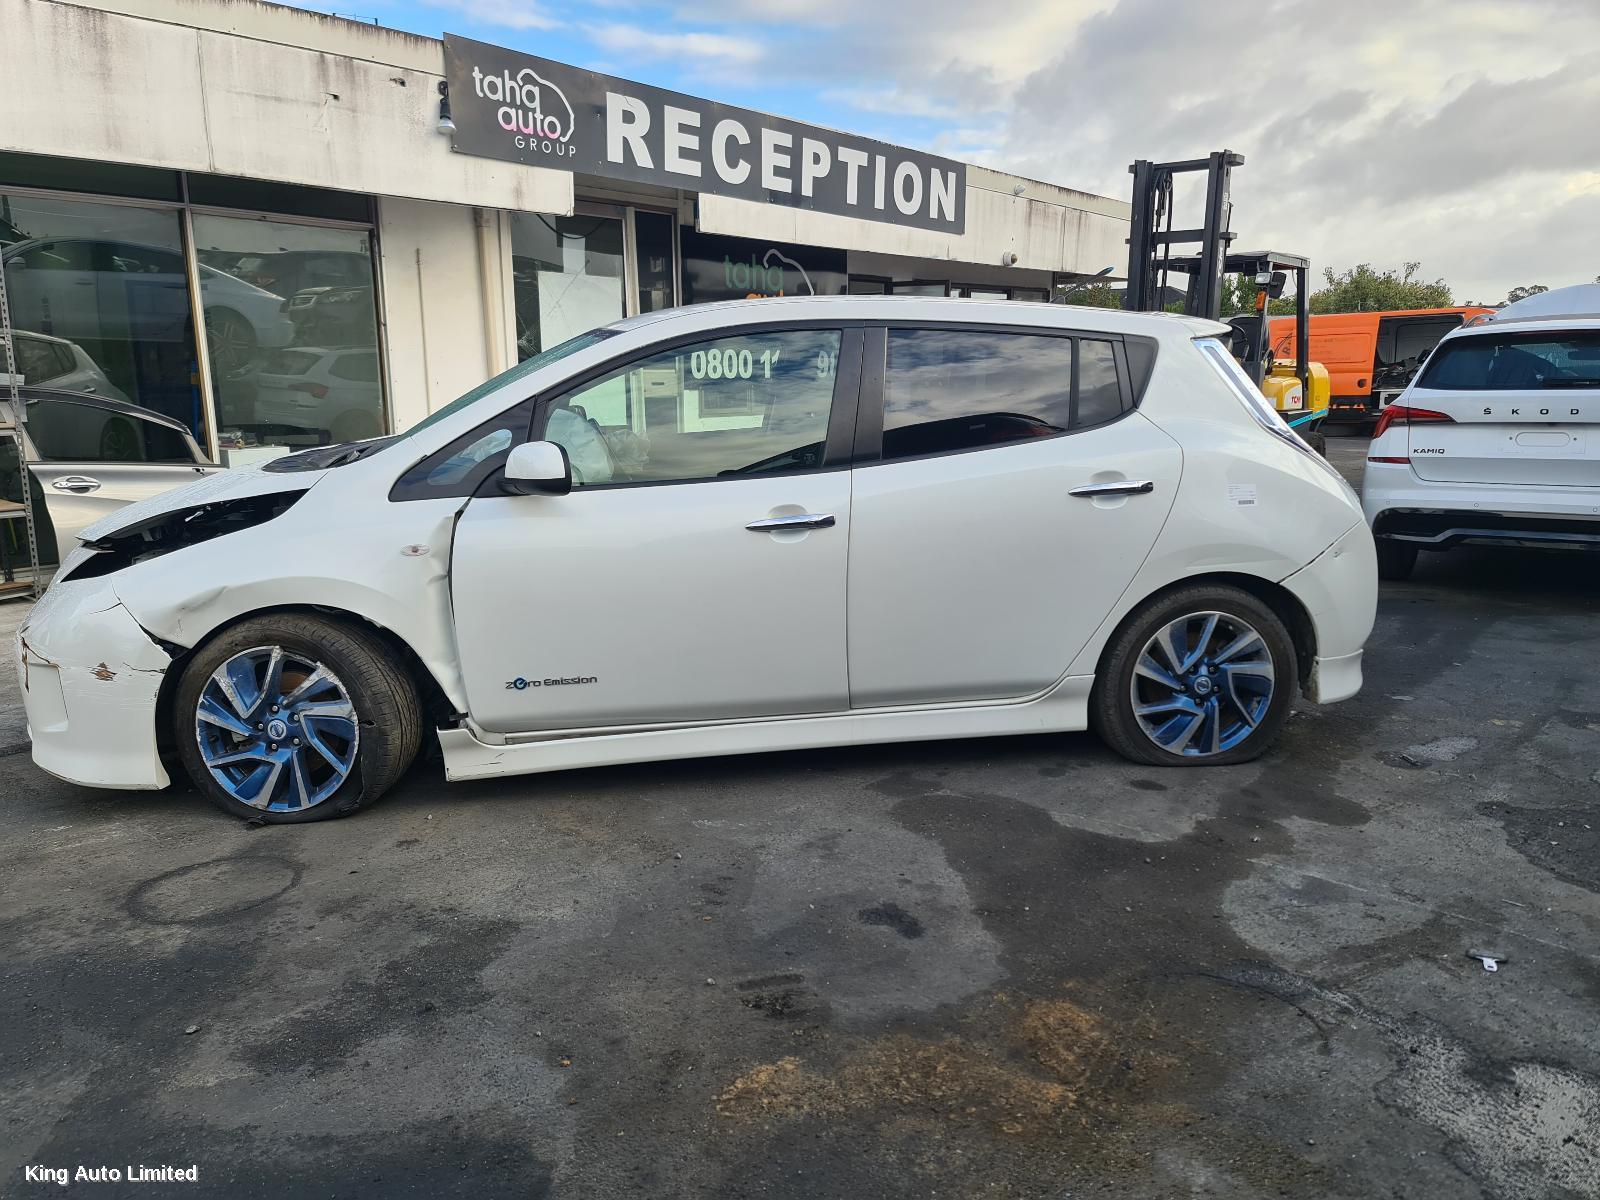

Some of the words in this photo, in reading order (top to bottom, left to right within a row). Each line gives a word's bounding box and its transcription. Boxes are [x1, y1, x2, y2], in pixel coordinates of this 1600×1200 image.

[497, 106, 561, 139] auto
[515, 135, 576, 157] GROUP
[605, 91, 957, 223] RECEPTION
[690, 349, 753, 379] 0800
[1413, 447, 1446, 455] KAMIQ
[543, 676, 598, 687] Emission
